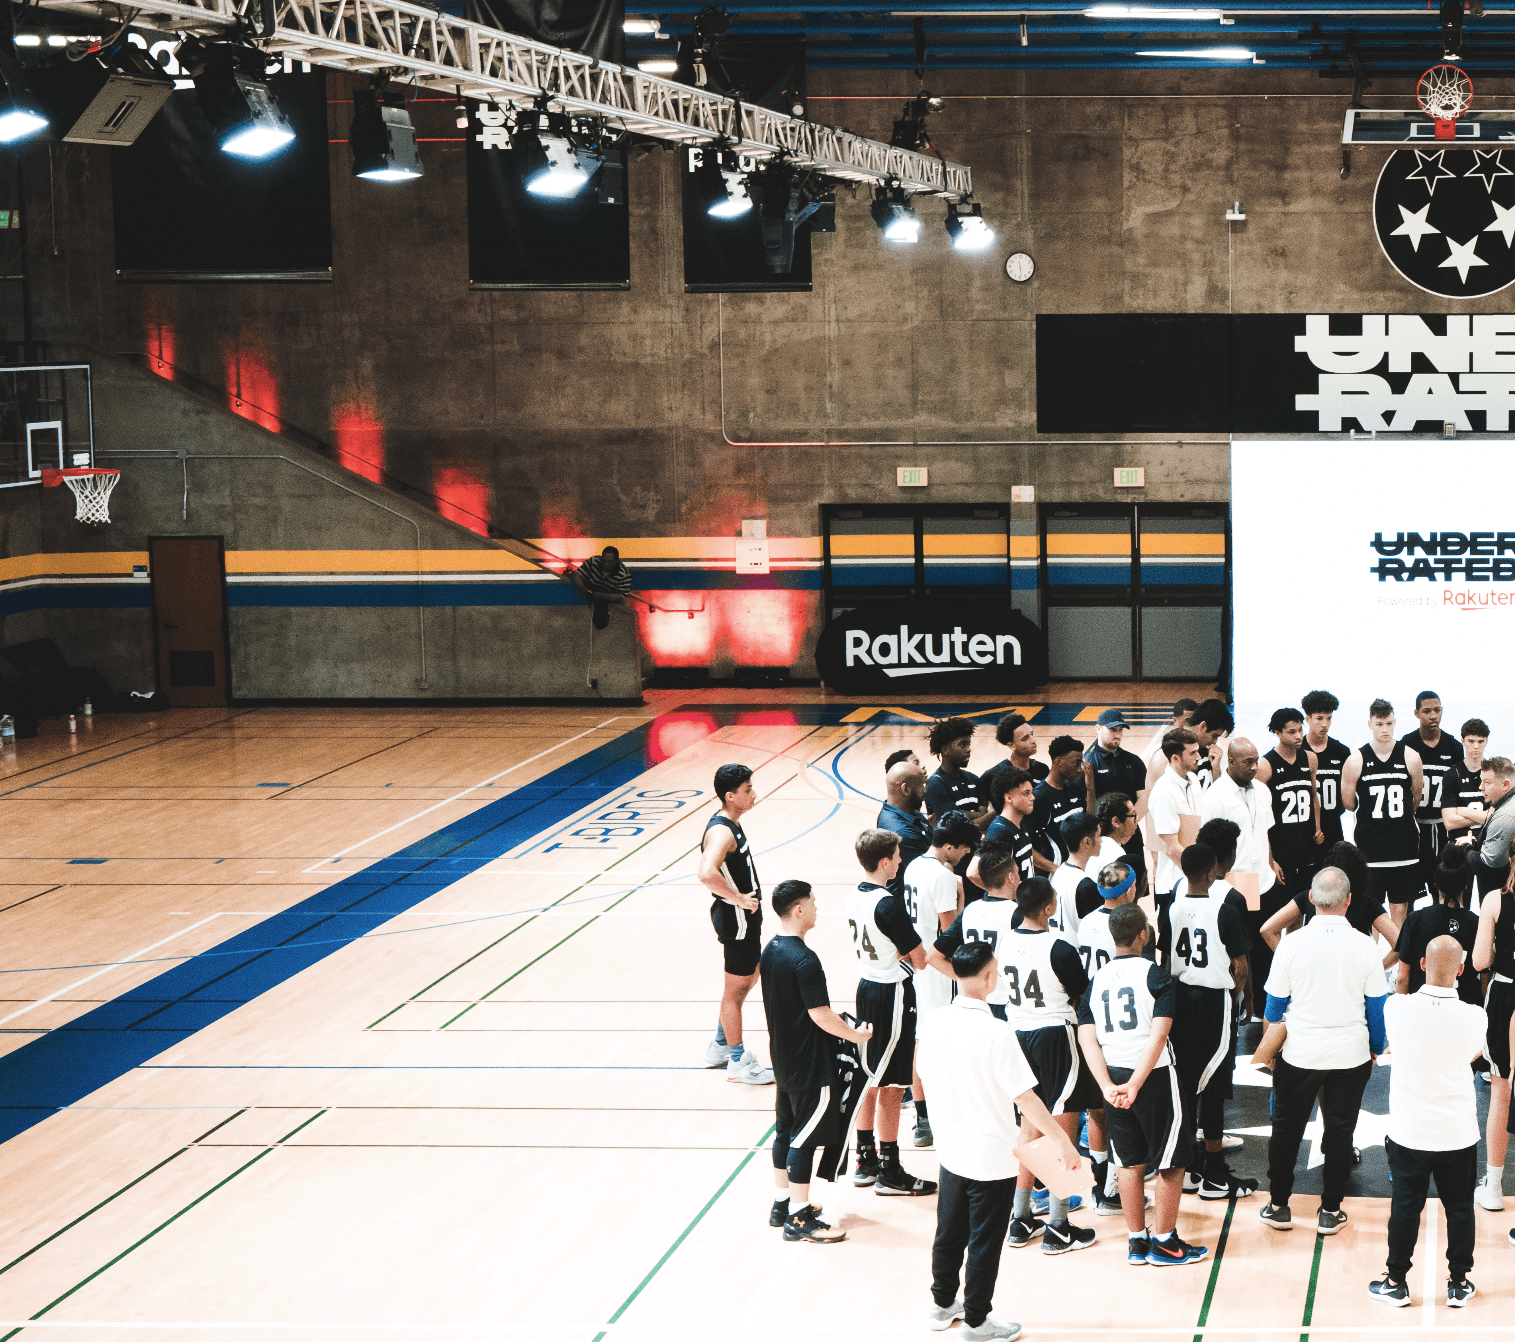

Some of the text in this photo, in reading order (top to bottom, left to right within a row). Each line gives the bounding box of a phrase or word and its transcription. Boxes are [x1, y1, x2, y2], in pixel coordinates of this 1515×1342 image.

[902, 469, 922, 485] EXIT
[1119, 469, 1139, 485] EXIT
[1377, 596, 1423, 607] Powered
[1426, 596, 1439, 608] by
[845, 624, 1022, 667] Rakuten
[1281, 789, 1311, 824] 28
[1369, 784, 1404, 819] 78
[1175, 927, 1209, 969] 43
[1003, 965, 1047, 1009] 34
[1101, 986, 1140, 1034] 13
